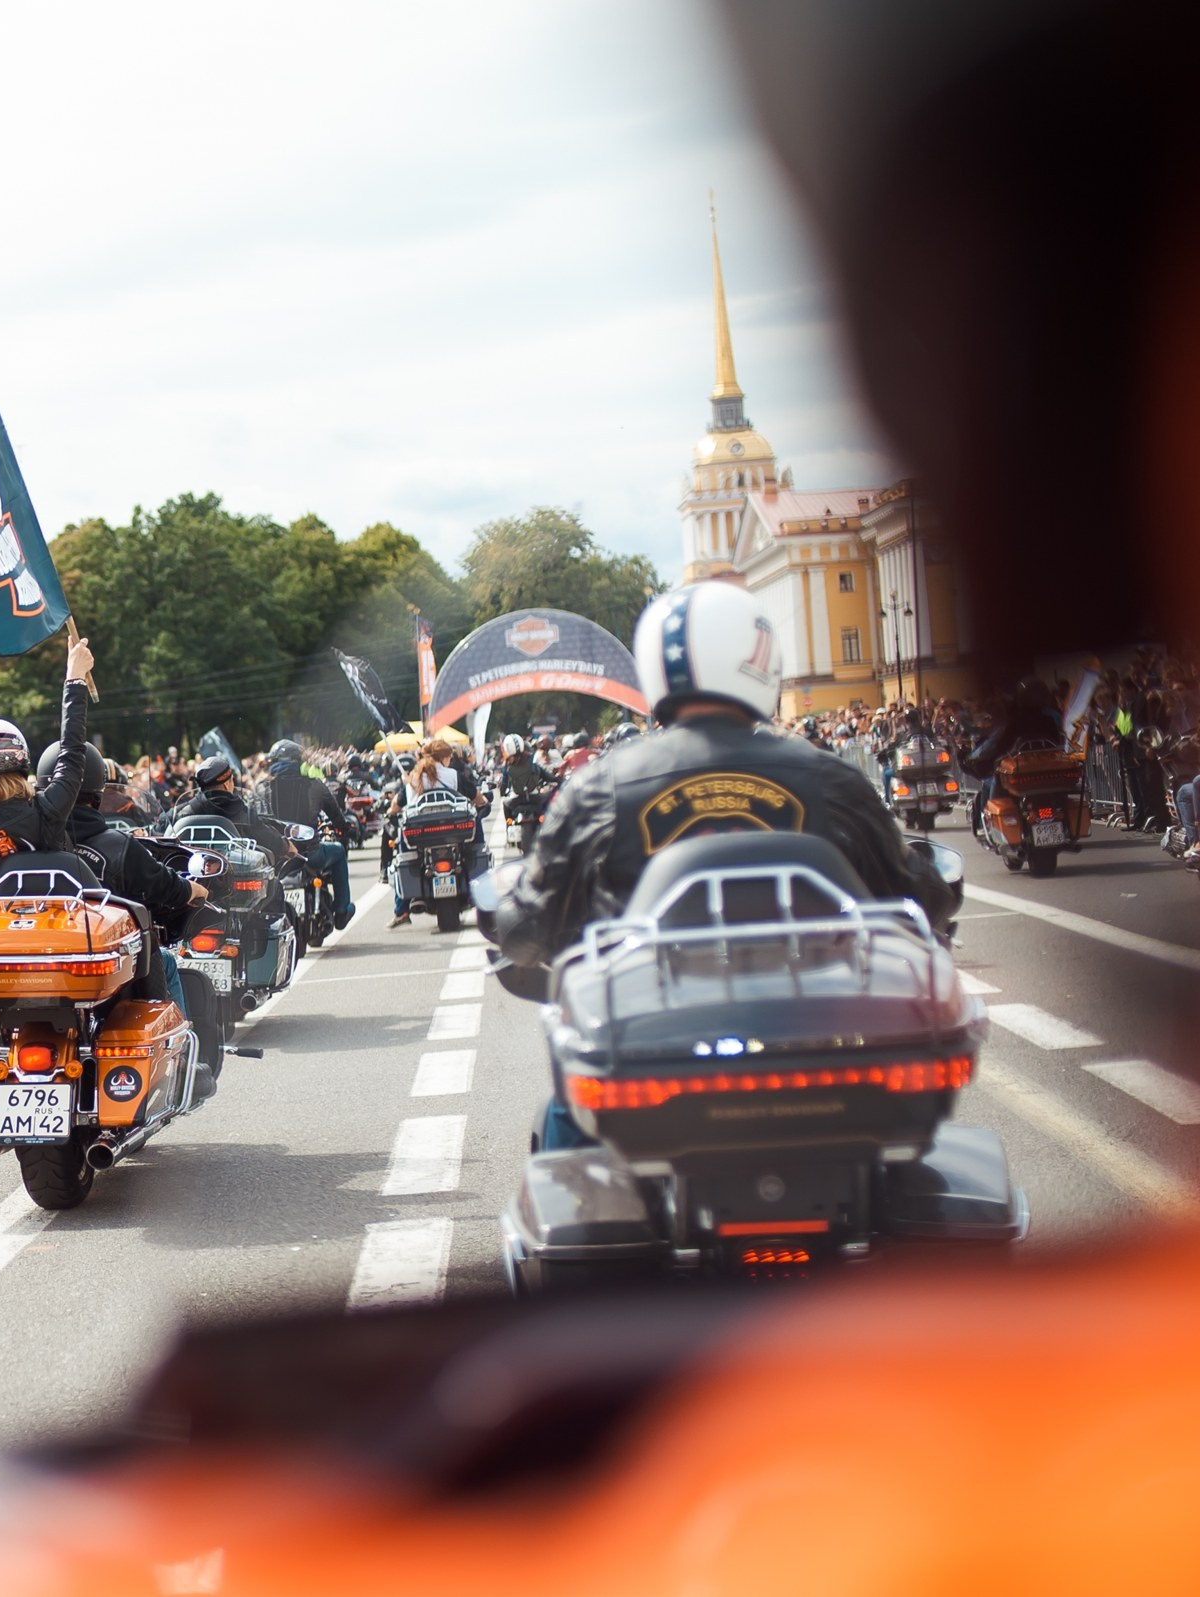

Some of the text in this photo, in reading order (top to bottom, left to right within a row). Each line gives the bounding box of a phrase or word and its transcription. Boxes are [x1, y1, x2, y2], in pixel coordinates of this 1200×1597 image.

[683, 780, 786, 808] PETERSBURG
[692, 796, 751, 812] RUSSIA
[75, 848, 100, 863] APTER
[8, 1089, 59, 1107] 6796
[0, 1116, 64, 1133] AM 42
